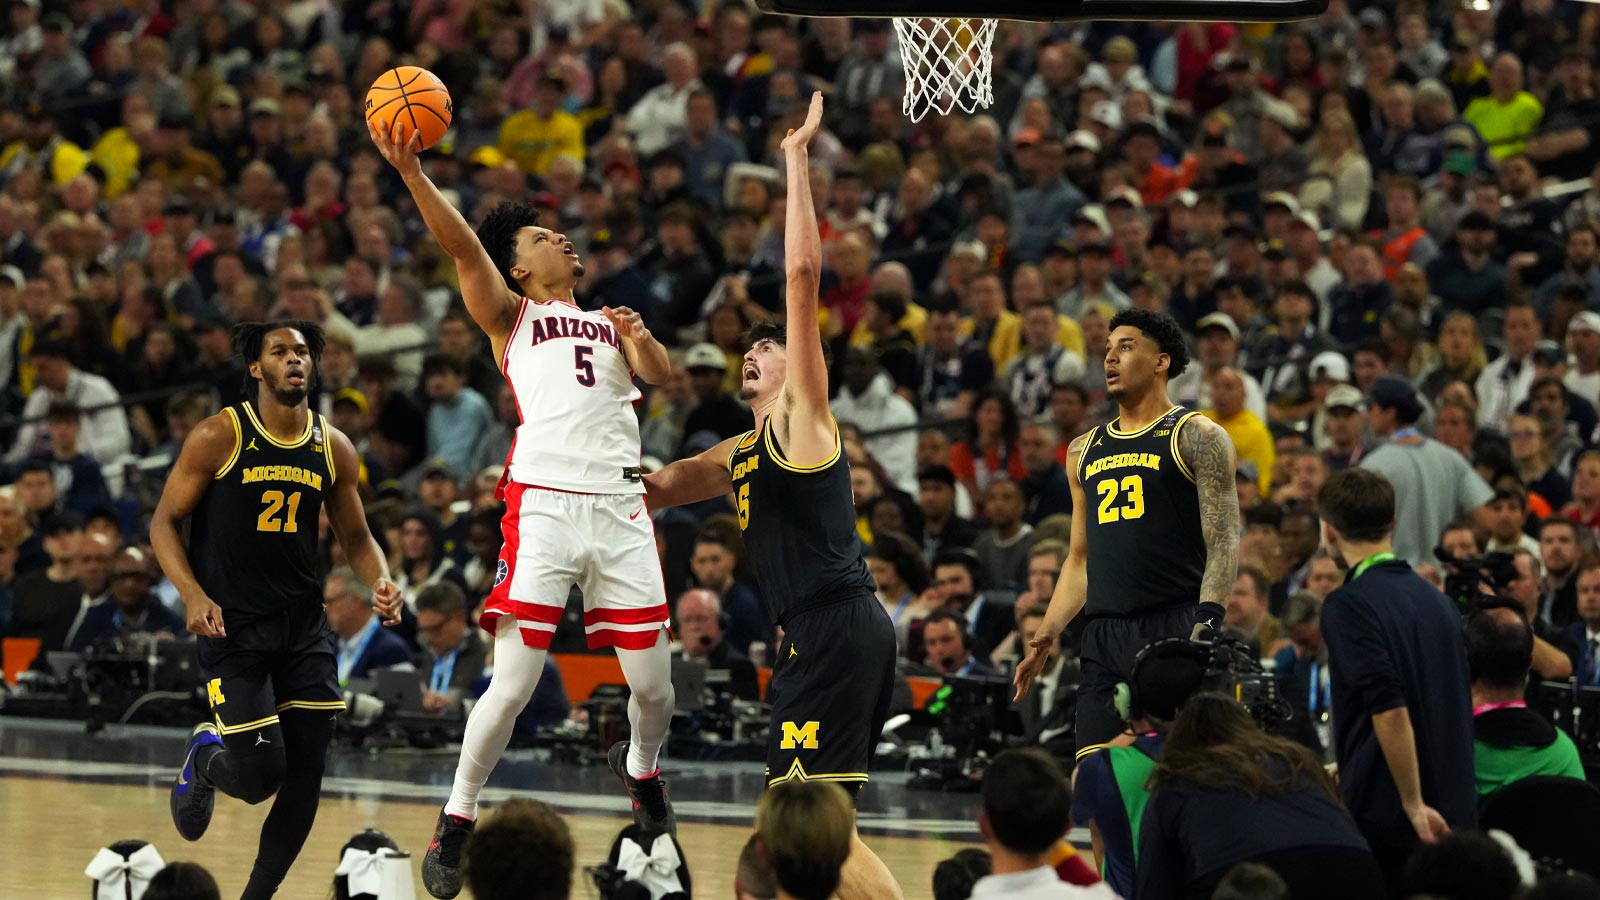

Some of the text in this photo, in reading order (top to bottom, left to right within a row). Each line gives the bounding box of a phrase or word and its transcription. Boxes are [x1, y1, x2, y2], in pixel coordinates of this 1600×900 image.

[574, 345, 596, 388] 5
[242, 465, 323, 491] MICHIGAN
[1085, 453, 1161, 480] MICHIGAN
[256, 490, 302, 533] 21
[1097, 474, 1145, 525] 23
[206, 677, 226, 709] M
[780, 721, 820, 750] M
